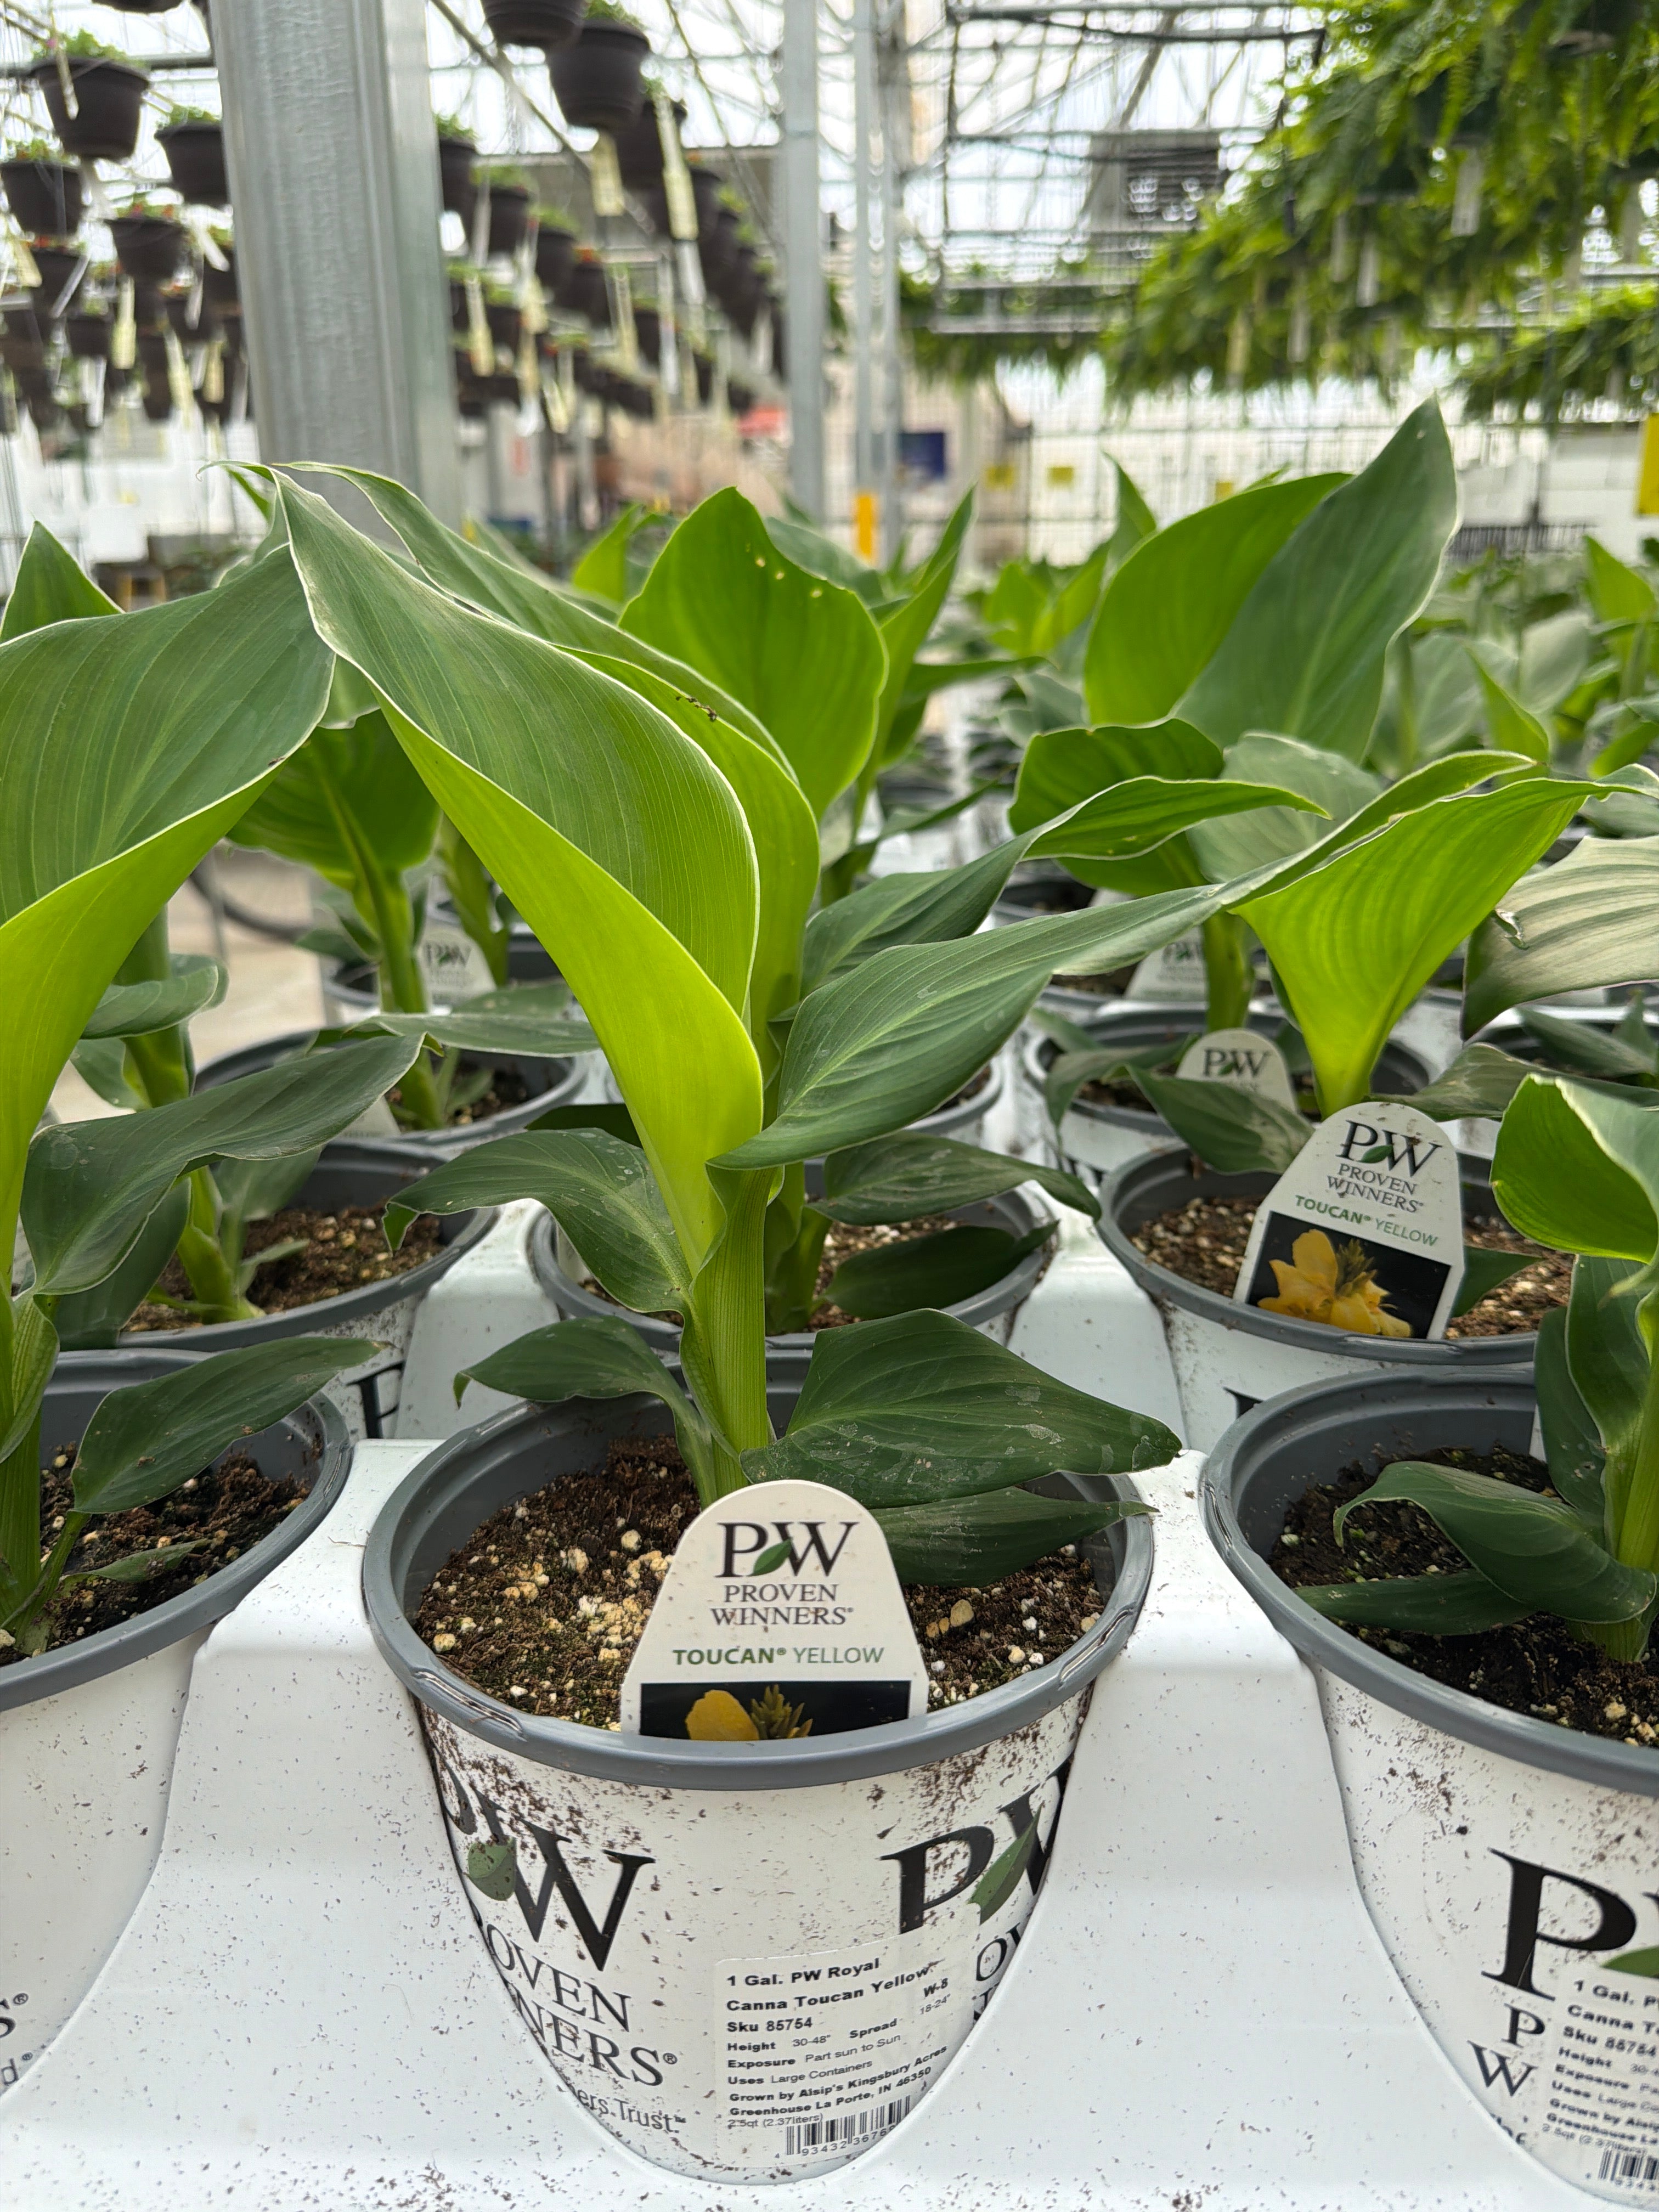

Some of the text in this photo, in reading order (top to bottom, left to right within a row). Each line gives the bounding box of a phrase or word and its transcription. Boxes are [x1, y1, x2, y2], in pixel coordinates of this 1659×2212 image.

[1203, 1047, 1272, 1078] PW
[1336, 1119, 1442, 1178] PW
[1338, 1163, 1418, 1195] PROVEN
[1375, 1218, 1438, 1247] YELLOW
[714, 1522, 860, 1578] PW
[723, 1584, 839, 1603] PROVEN
[793, 1647, 884, 1664] YELLOW
[727, 1957, 880, 1987] 1 Gal. PW Royal
[726, 1967, 930, 2011] Canna Toucan Yellow
[1573, 1979, 1584, 1992] 1
[1593, 1984, 1634, 2005] Gal.
[727, 2017, 813, 2032] Sku 85754
[849, 2018, 898, 2039] Spread
[1567, 2004, 1634, 2030] Canna
[727, 2034, 831, 2052] Height 30-48"
[727, 2035, 901, 2069] Exposure Part sun to Sun
[727, 2061, 873, 2085] Uses Large Containers
[729, 2046, 947, 2102] Grown by Alsip's Kingsbury Acres
[730, 2066, 932, 2116] Greenhouse La Porte, IN 46350
[801, 2141, 847, 2157] 93432
